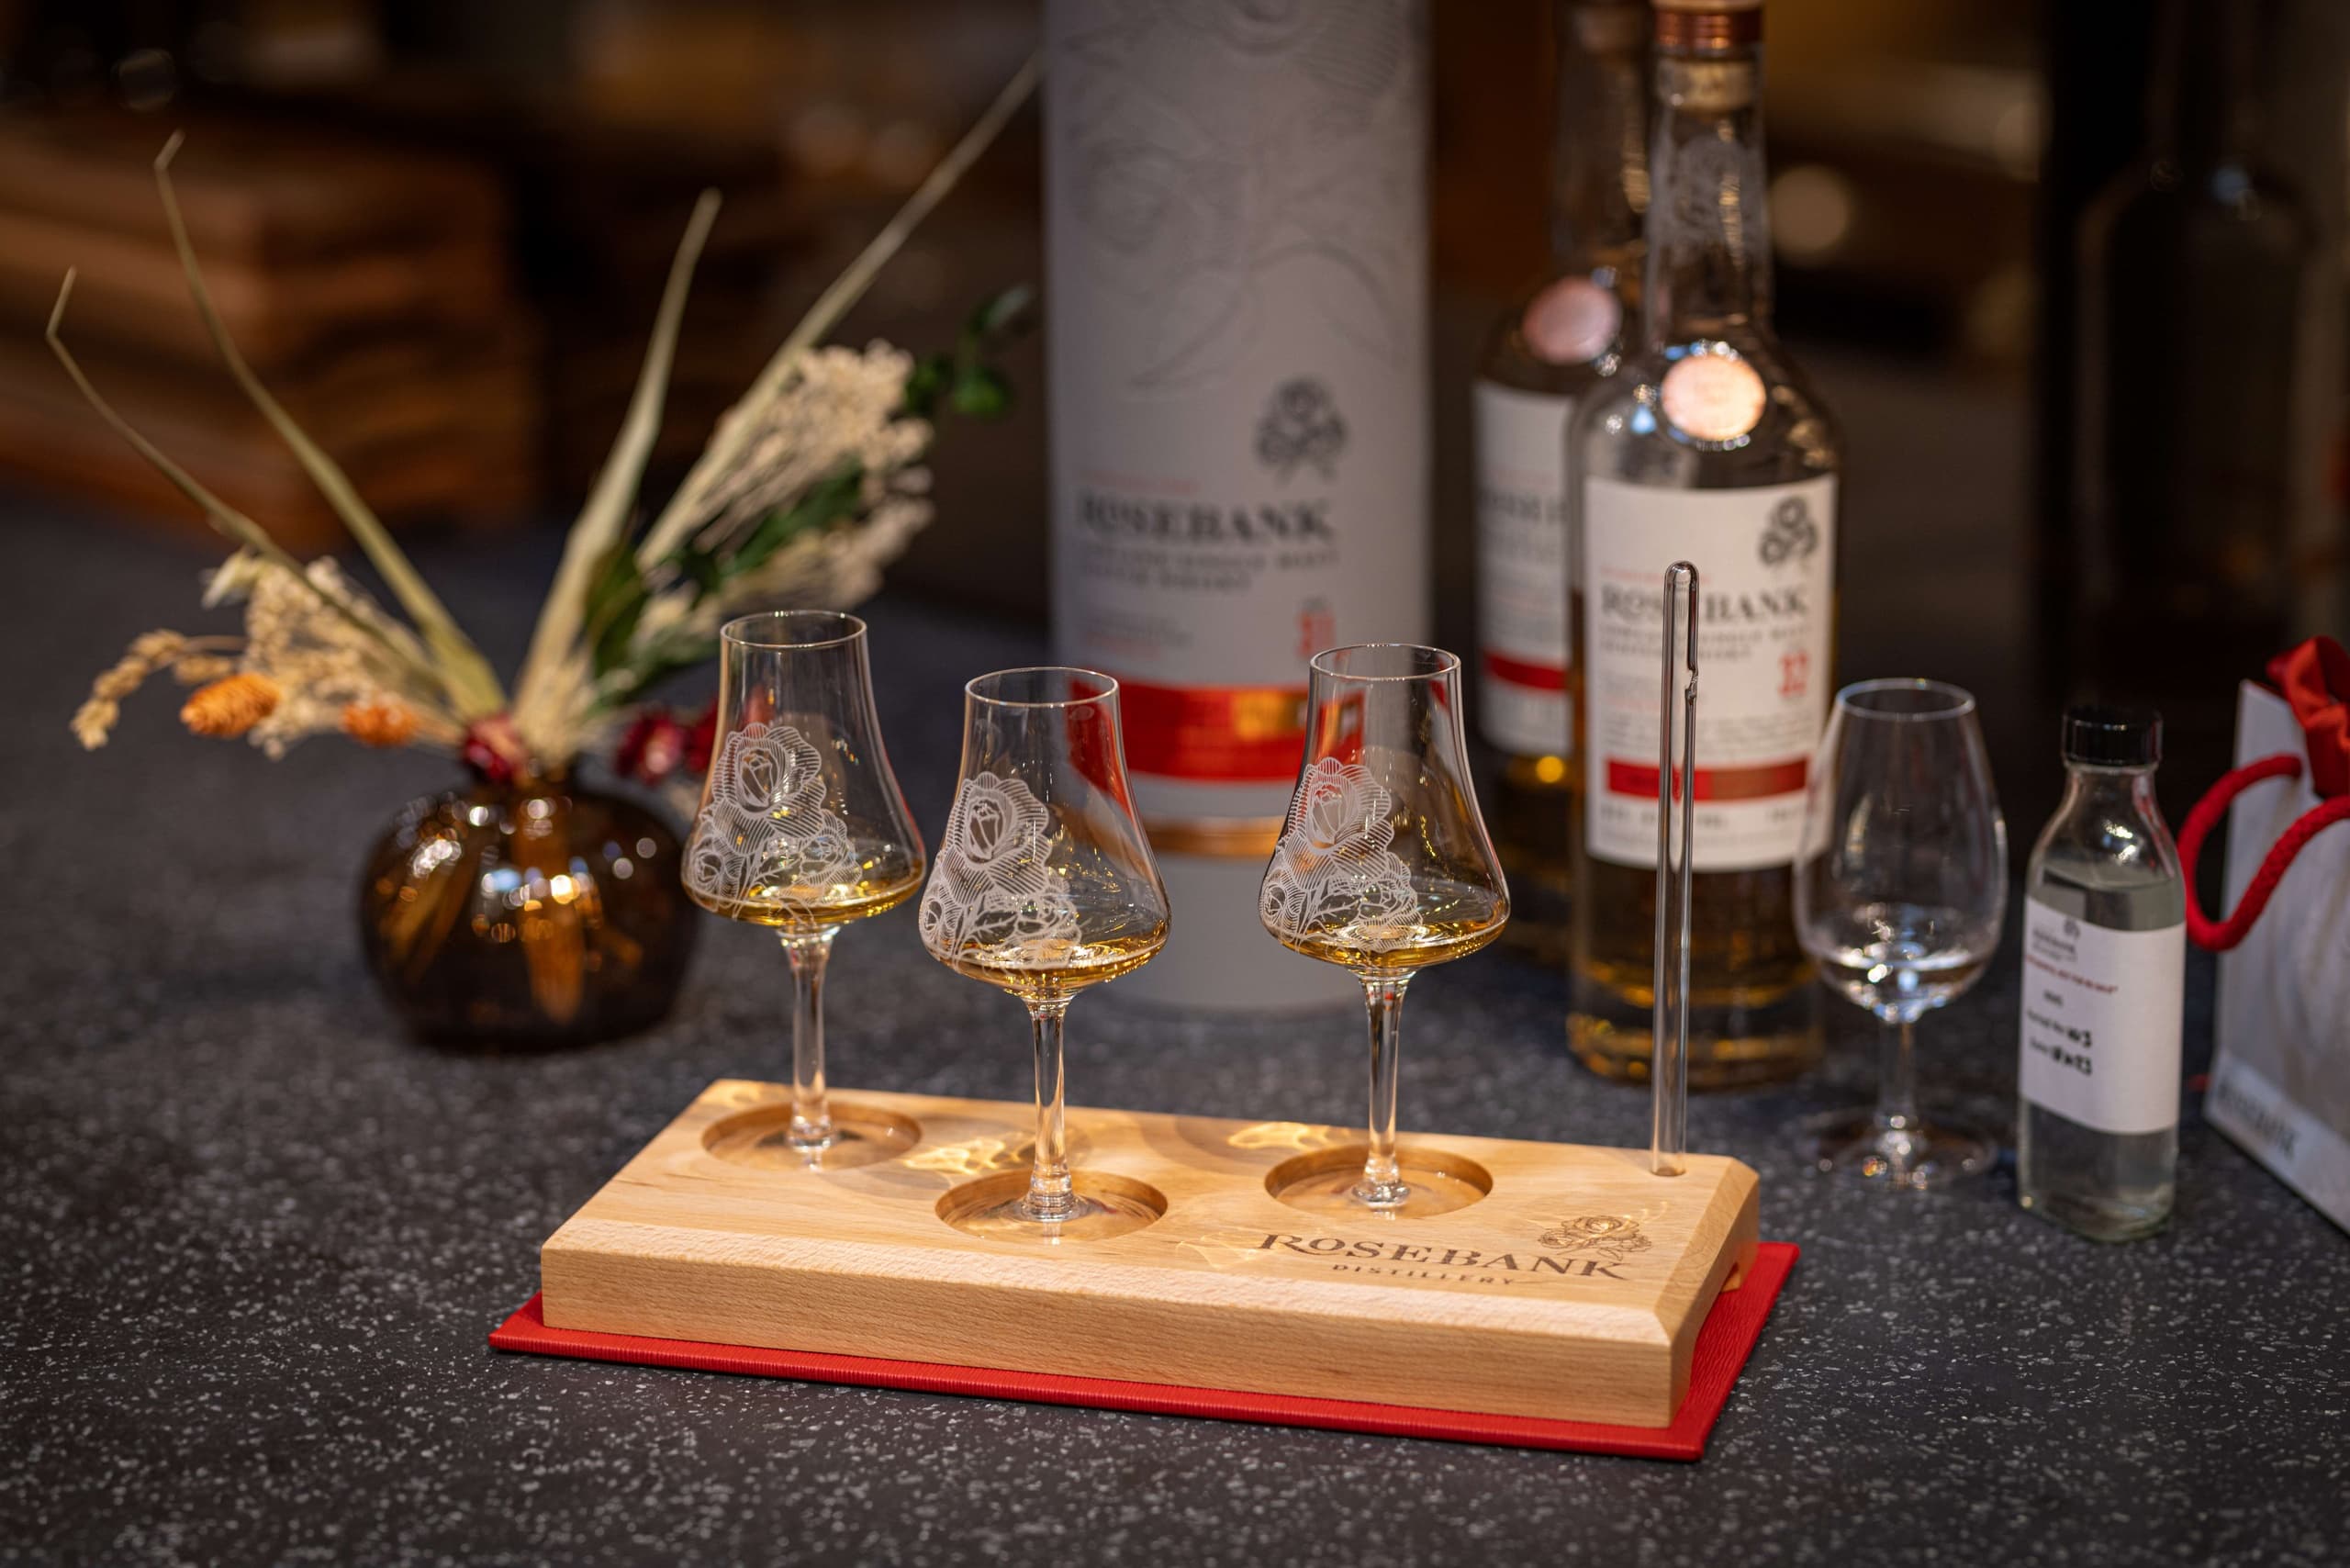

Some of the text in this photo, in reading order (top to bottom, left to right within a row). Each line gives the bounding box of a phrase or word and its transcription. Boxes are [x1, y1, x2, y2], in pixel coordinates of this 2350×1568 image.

[1601, 583, 1808, 624] ROSBANK
[1259, 1233, 1631, 1281] ROSEBANK
[1333, 1263, 1516, 1285] DISTILLERY
